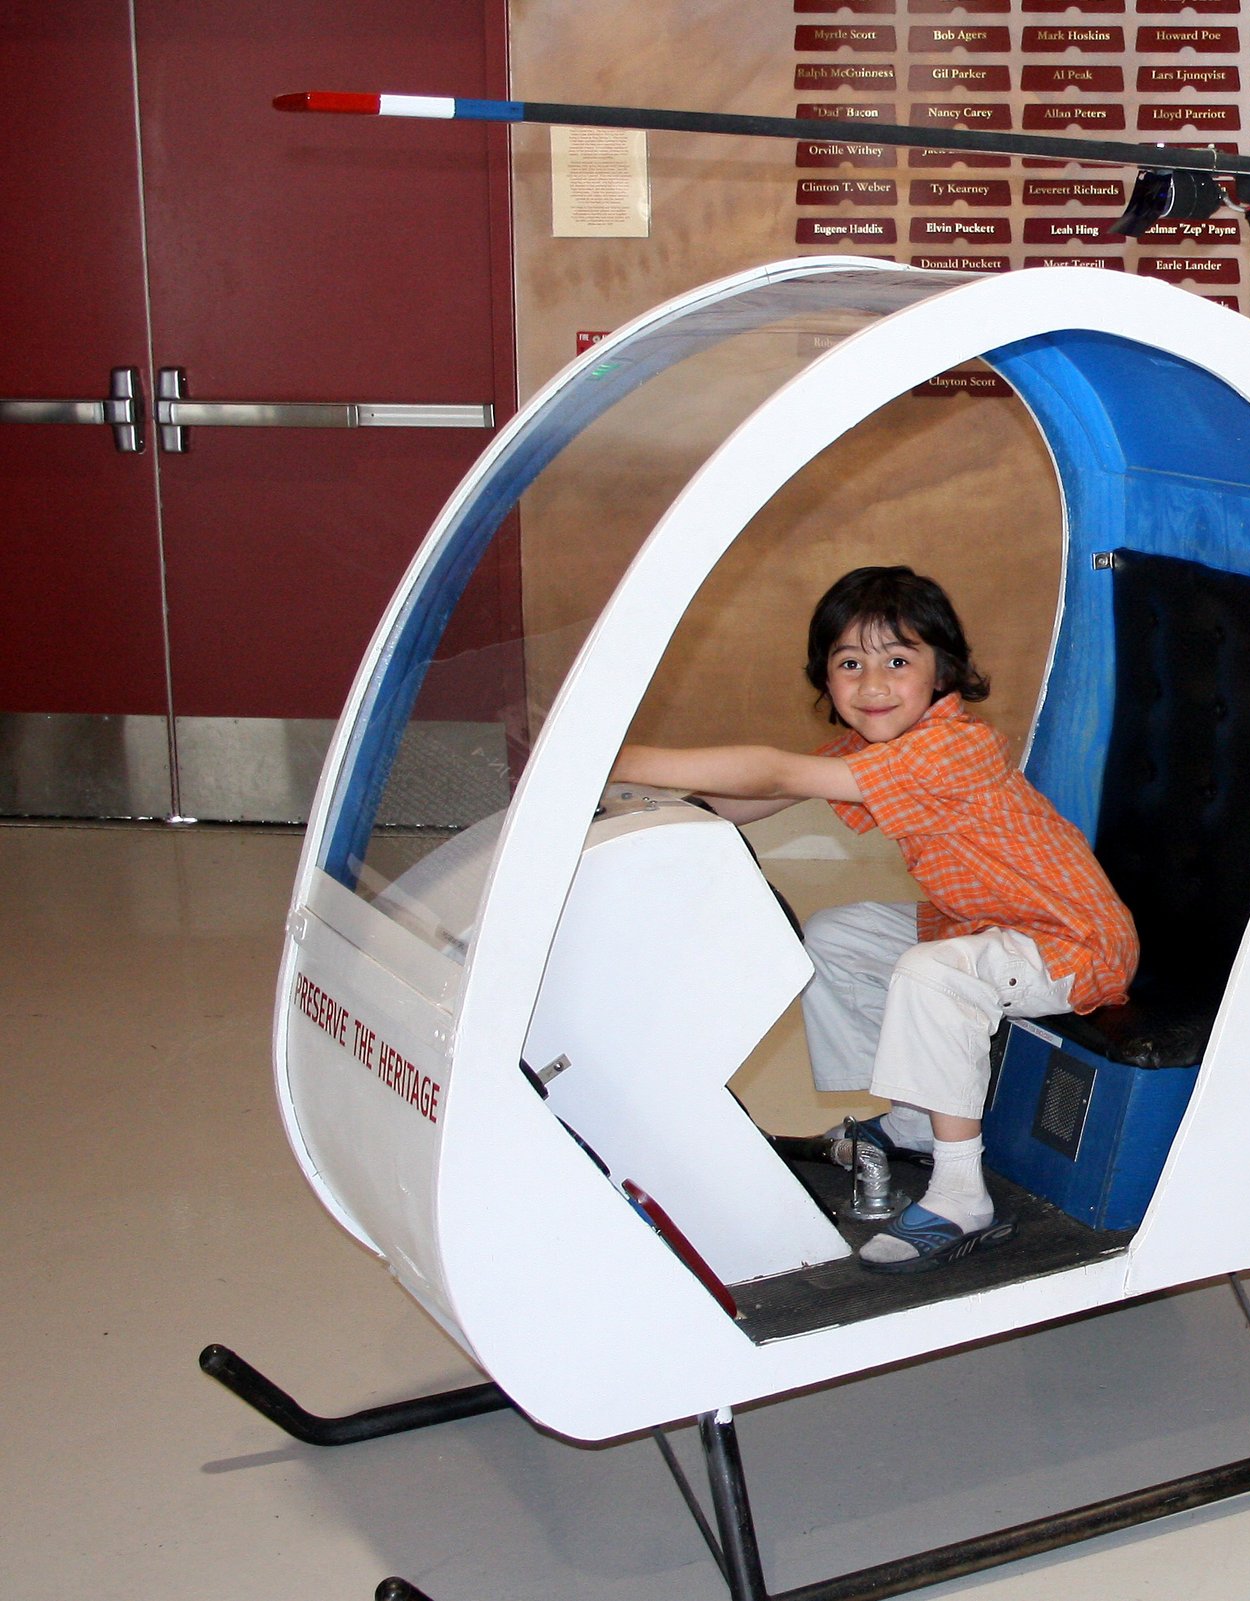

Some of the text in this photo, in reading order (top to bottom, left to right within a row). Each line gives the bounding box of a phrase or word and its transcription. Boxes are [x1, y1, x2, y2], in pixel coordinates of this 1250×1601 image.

[815, 30, 876, 41] Myrtle Scott
[933, 30, 987, 42] Bob Agers
[1037, 31, 1110, 40] Mark Hoskins
[1156, 31, 1221, 40] Howard Poe
[797, 67, 894, 79] Ralph McGuinness
[932, 69, 987, 79] Gil Parker
[1053, 70, 1093, 80] Al Peak
[1152, 70, 1226, 82] Lars Ljunqvist
[813, 106, 879, 118] "Dad" Bacon
[928, 108, 993, 119] Nancy Carey
[1045, 109, 1107, 118] Allan Peters
[1153, 109, 1226, 121] Lloyd Parriott
[809, 145, 884, 157] Orville Withey
[802, 182, 891, 192] Clinton T. Weber
[931, 184, 989, 195] Ty Kearney
[1029, 185, 1119, 195] Leverett Richards
[814, 224, 883, 236] Eugene Haddix
[926, 223, 995, 233] Elvin Puckett
[1051, 225, 1099, 237] Leah Hing
[1145, 223, 1236, 237] elmar "Zep" Payne
[921, 259, 1002, 269] Donald Puckett
[1156, 261, 1222, 270] Earle Lander
[928, 376, 996, 388] Clayton Scott
[294, 972, 440, 1123] PRESERVE THE HERITAGE
